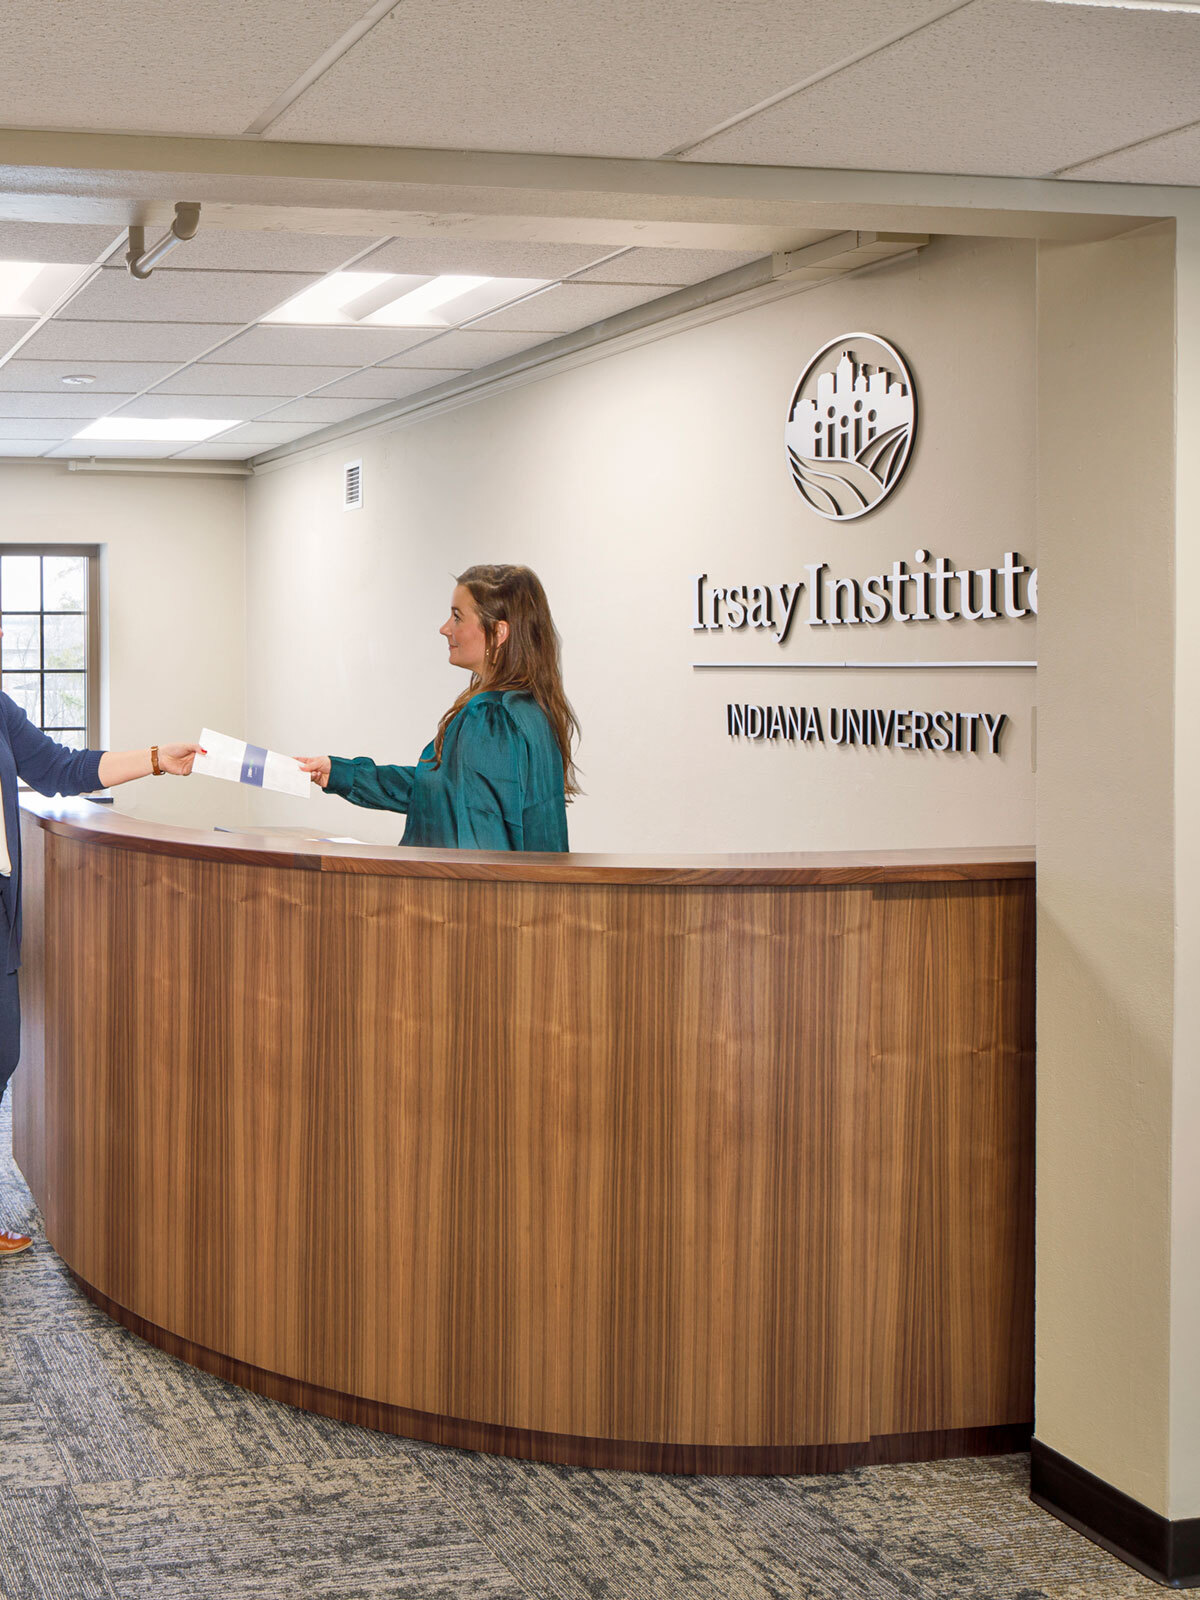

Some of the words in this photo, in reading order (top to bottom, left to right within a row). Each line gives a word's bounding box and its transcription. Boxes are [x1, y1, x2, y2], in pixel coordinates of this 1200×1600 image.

[688, 573, 804, 643] Irsay
[726, 703, 824, 743] INDIANA
[827, 708, 1008, 754] UNIVERSITY
